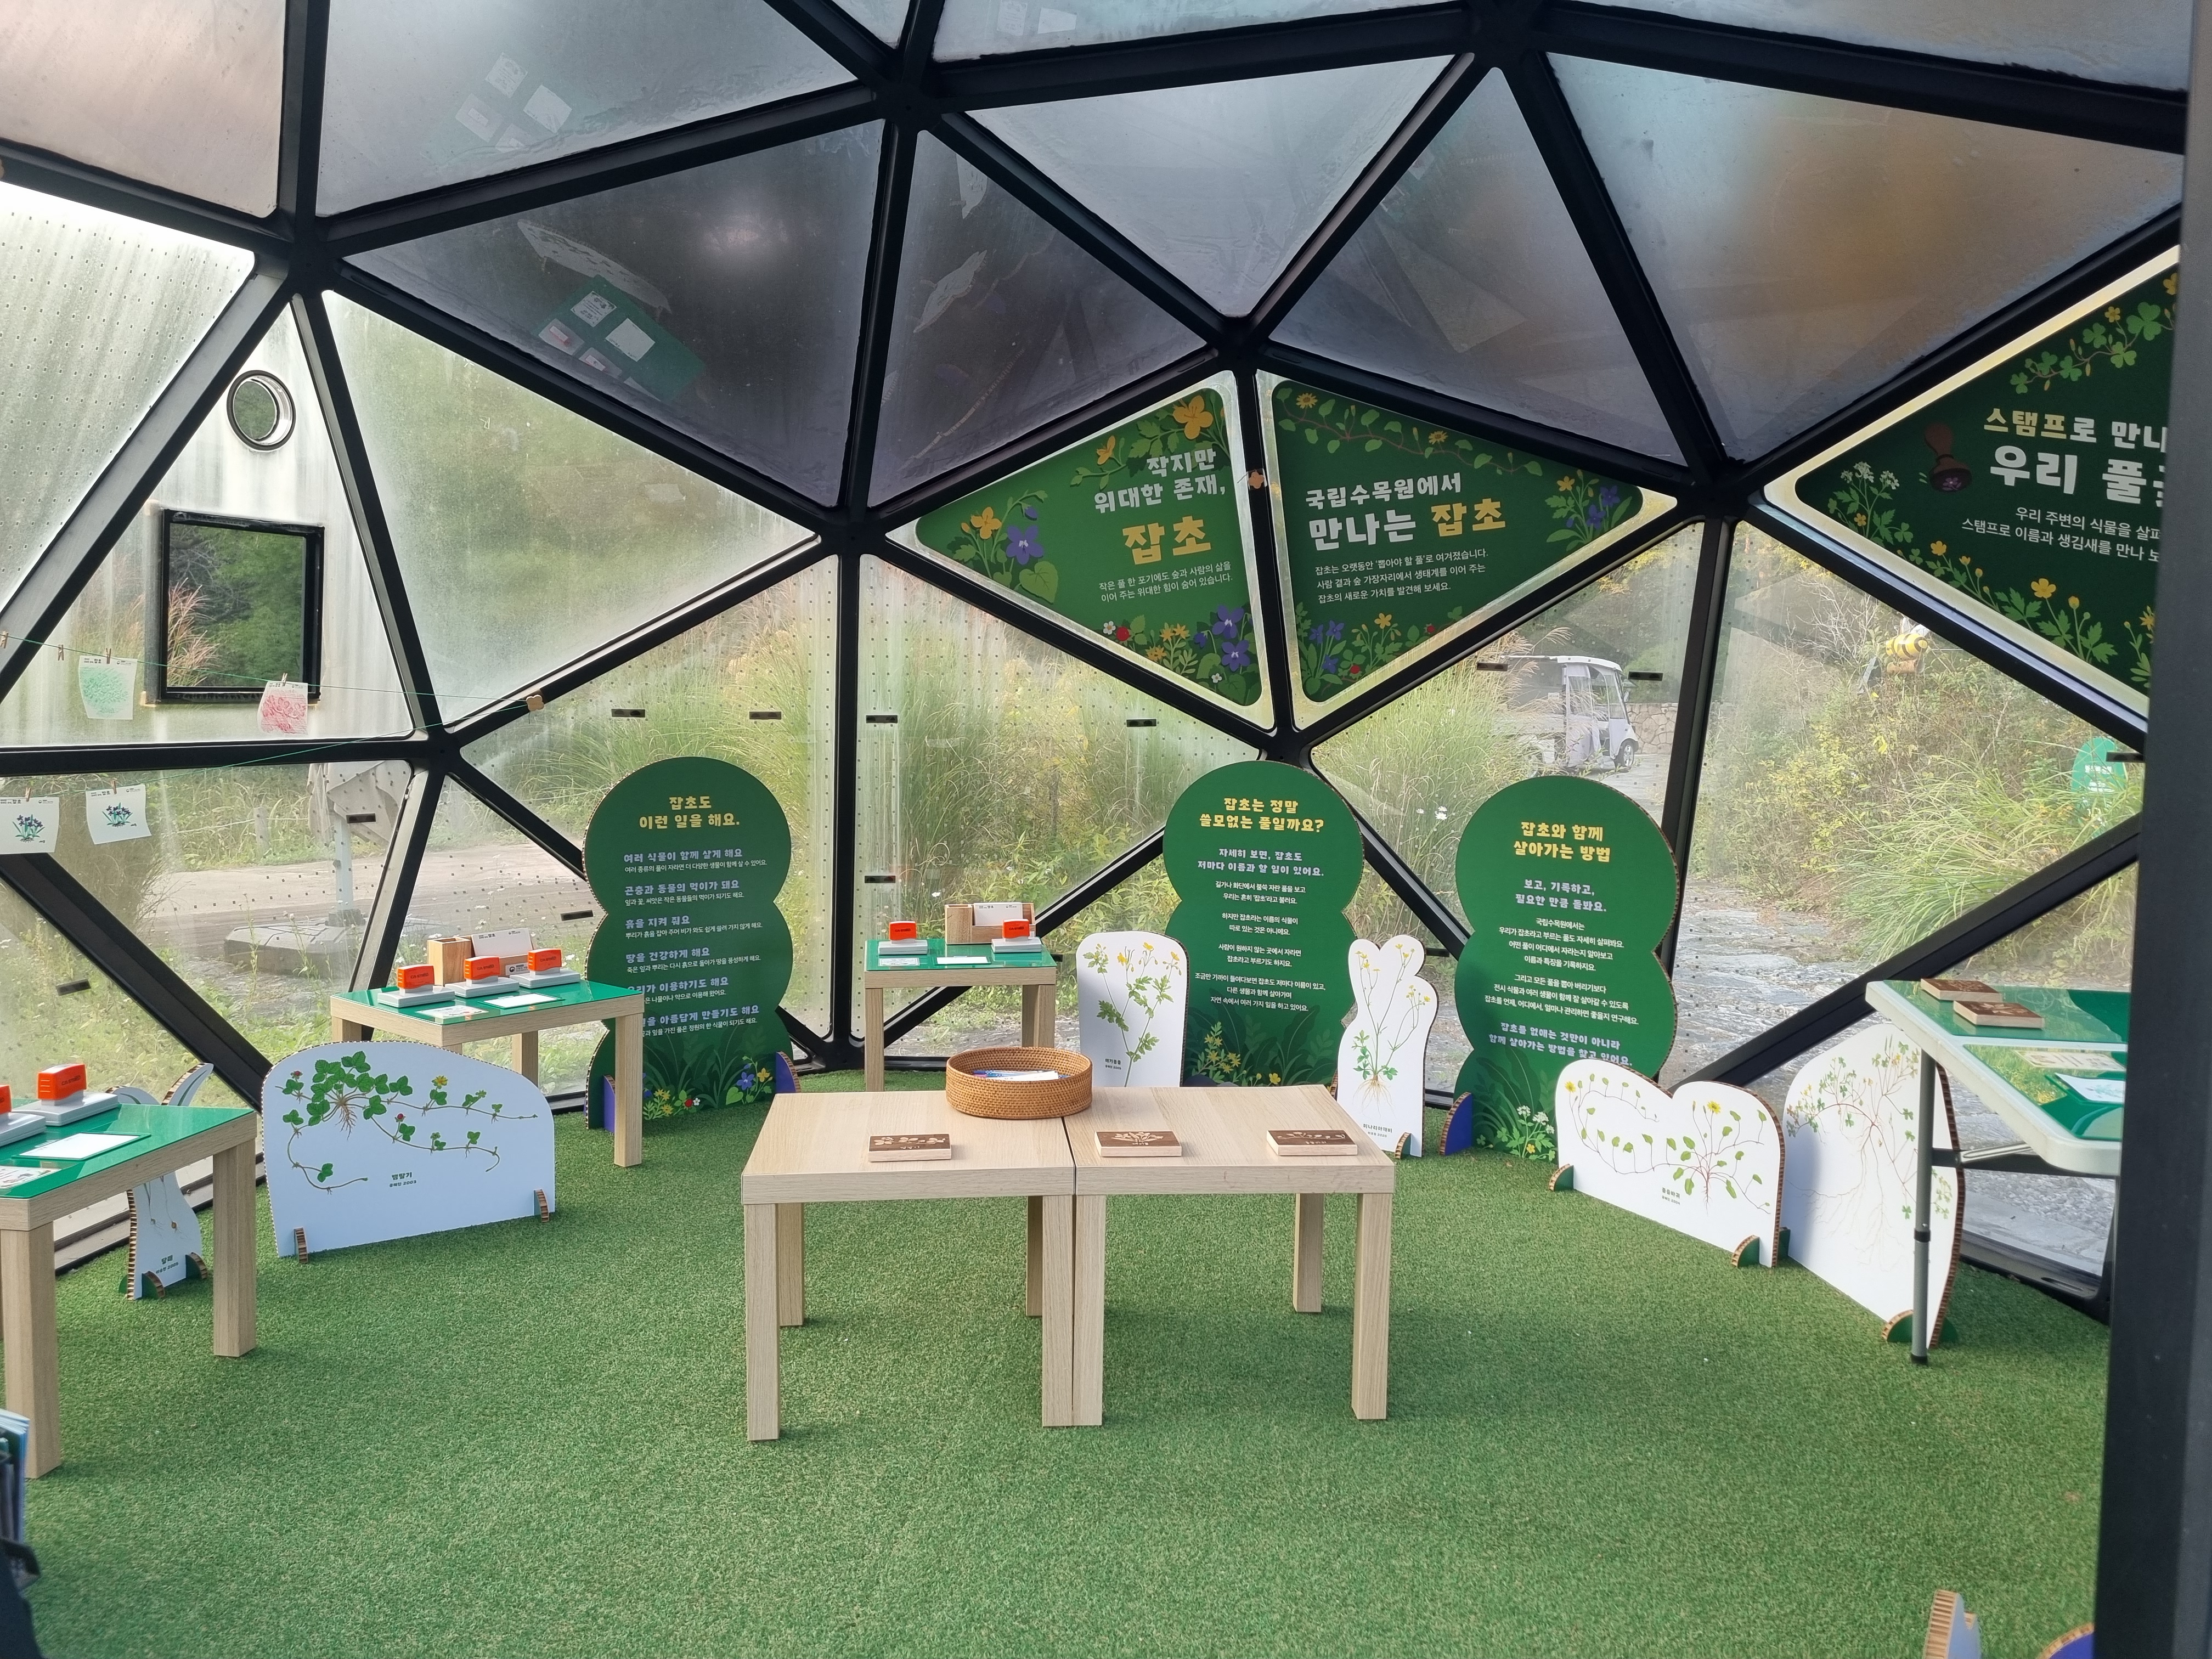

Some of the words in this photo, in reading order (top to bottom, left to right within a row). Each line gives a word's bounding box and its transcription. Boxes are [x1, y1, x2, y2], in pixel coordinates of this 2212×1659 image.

[1984, 408, 2097, 443] 스탬프로
[1147, 448, 1216, 477] 작지만
[1990, 445, 2078, 494] 우리
[2102, 459, 2165, 507] 풀
[1094, 483, 1164, 514] 위대한
[1173, 473, 1226, 500] 존재,
[1305, 472, 1462, 510] 국립수목원에서
[1309, 509, 1417, 551] 만나는
[1430, 498, 1506, 537] 잡초
[2015, 507, 2041, 523] 우리
[2045, 511, 2085, 530] 주변의
[2090, 519, 2131, 535] 식물을
[1122, 515, 1212, 565] 잡초
[1961, 519, 2011, 537] 스탬프로
[2015, 527, 2054, 545] 이름과
[2057, 534, 2112, 555] 생김새를
[2116, 543, 2145, 561] 만나
[1315, 565, 1339, 575] 잡초는
[1341, 561, 1374, 572] 오랫동안
[1404, 556, 1413, 566] 할
[1435, 549, 1488, 561] 여겨졌습니다.
[1098, 580, 1115, 591] 작은
[1117, 579, 1126, 589] 풀
[1127, 577, 1136, 587] 한
[1138, 572, 1170, 584] 포기에도
[1171, 568, 1187, 579] 숲과
[1189, 564, 1213, 575] 사람의
[1215, 561, 1231, 572] 삶을
[1317, 579, 1333, 589] 사람
[1353, 577, 1361, 586] 숲
[1363, 571, 1412, 584] 가장자리에서
[1414, 567, 1447, 579] 생태계를
[1449, 565, 1466, 575] 이어
[1469, 563, 1486, 573] 주는
[1101, 592, 1117, 602] 이어
[1119, 590, 1135, 600] 주는
[1137, 584, 1161, 596] 위대한
[1163, 581, 1179, 592] 힘이
[1181, 578, 1197, 589] 숨어
[1199, 573, 1233, 586] 있습니다.
[1318, 592, 1342, 603] 잡초의
[1344, 590, 1368, 600] 새로운
[1370, 587, 1395, 597] 가치를
[1397, 584, 1421, 596] 발견해
[1424, 582, 1451, 592] 보세요.
[669, 795, 712, 810] 잡초도
[1223, 798, 1265, 812] 잡초는
[1269, 800, 1298, 814] 정말
[639, 815, 668, 829] 이런
[674, 814, 702, 828] 일을
[708, 812, 740, 826] 해요.
[1199, 814, 1253, 828] 쓸모없는
[1259, 816, 1324, 832] 풀일까요?
[1521, 822, 1566, 838] 잡초와
[1571, 825, 1603, 841] 함께
[623, 853, 643, 863] 여러
[647, 851, 676, 862] 식물이
[679, 850, 699, 860] 함께
[702, 849, 721, 859] 살게
[724, 848, 743, 857] 해요
[1218, 848, 1246, 858] 자세히
[1249, 850, 1271, 860] 보면,
[1274, 851, 1302, 861] 잡초도
[1513, 841, 1573, 859] 살아가는
[1580, 846, 1610, 862] 방법
[1197, 860, 1225, 870] 저마다
[1228, 862, 1255, 872] 이름과
[1258, 864, 1268, 873] 할
[1271, 865, 1289, 874] 일이
[1293, 866, 1324, 876] 있어요.
[624, 885, 654, 896] 곤충과
[657, 883, 685, 894] 동물의
[689, 881, 718, 891] 먹이가
[721, 879, 740, 889] 돼요
[1523, 879, 1546, 891] 보고,
[1550, 882, 1594, 895] 기록하고,
[1515, 894, 1545, 906] 필요한
[1549, 897, 1569, 909] 만큼
[1572, 899, 1606, 912] 돌봐요.
[625, 918, 644, 929] 흙을
[647, 917, 667, 927] 지켜
[671, 915, 690, 926] 줘요
[1535, 918, 1585, 930] 국립수목원에서는
[625, 952, 645, 963] 땅을
[648, 949, 688, 961] 건강하게
[691, 947, 710, 957] 해요
[659, 979, 707, 991] 이용하기도
[710, 977, 729, 986] 해요
[659, 1012, 698, 1024] 아름답게
[701, 1007, 738, 1020] 만들기도
[741, 1005, 759, 1014] 해요
[1500, 1022, 1527, 1035] 잡초를
[1530, 1027, 1557, 1039] 없애는
[1560, 1031, 1588, 1045] 것만이
[1591, 1037, 1621, 1049] 아니라
[1489, 1034, 1505, 1045] 함께
[1509, 1038, 1545, 1051] 살아가는
[1548, 1044, 1575, 1057] 방법을
[1363, 1124, 1392, 1133] 미나리아재비
[391, 1172, 413, 1180] 뱀딸기
